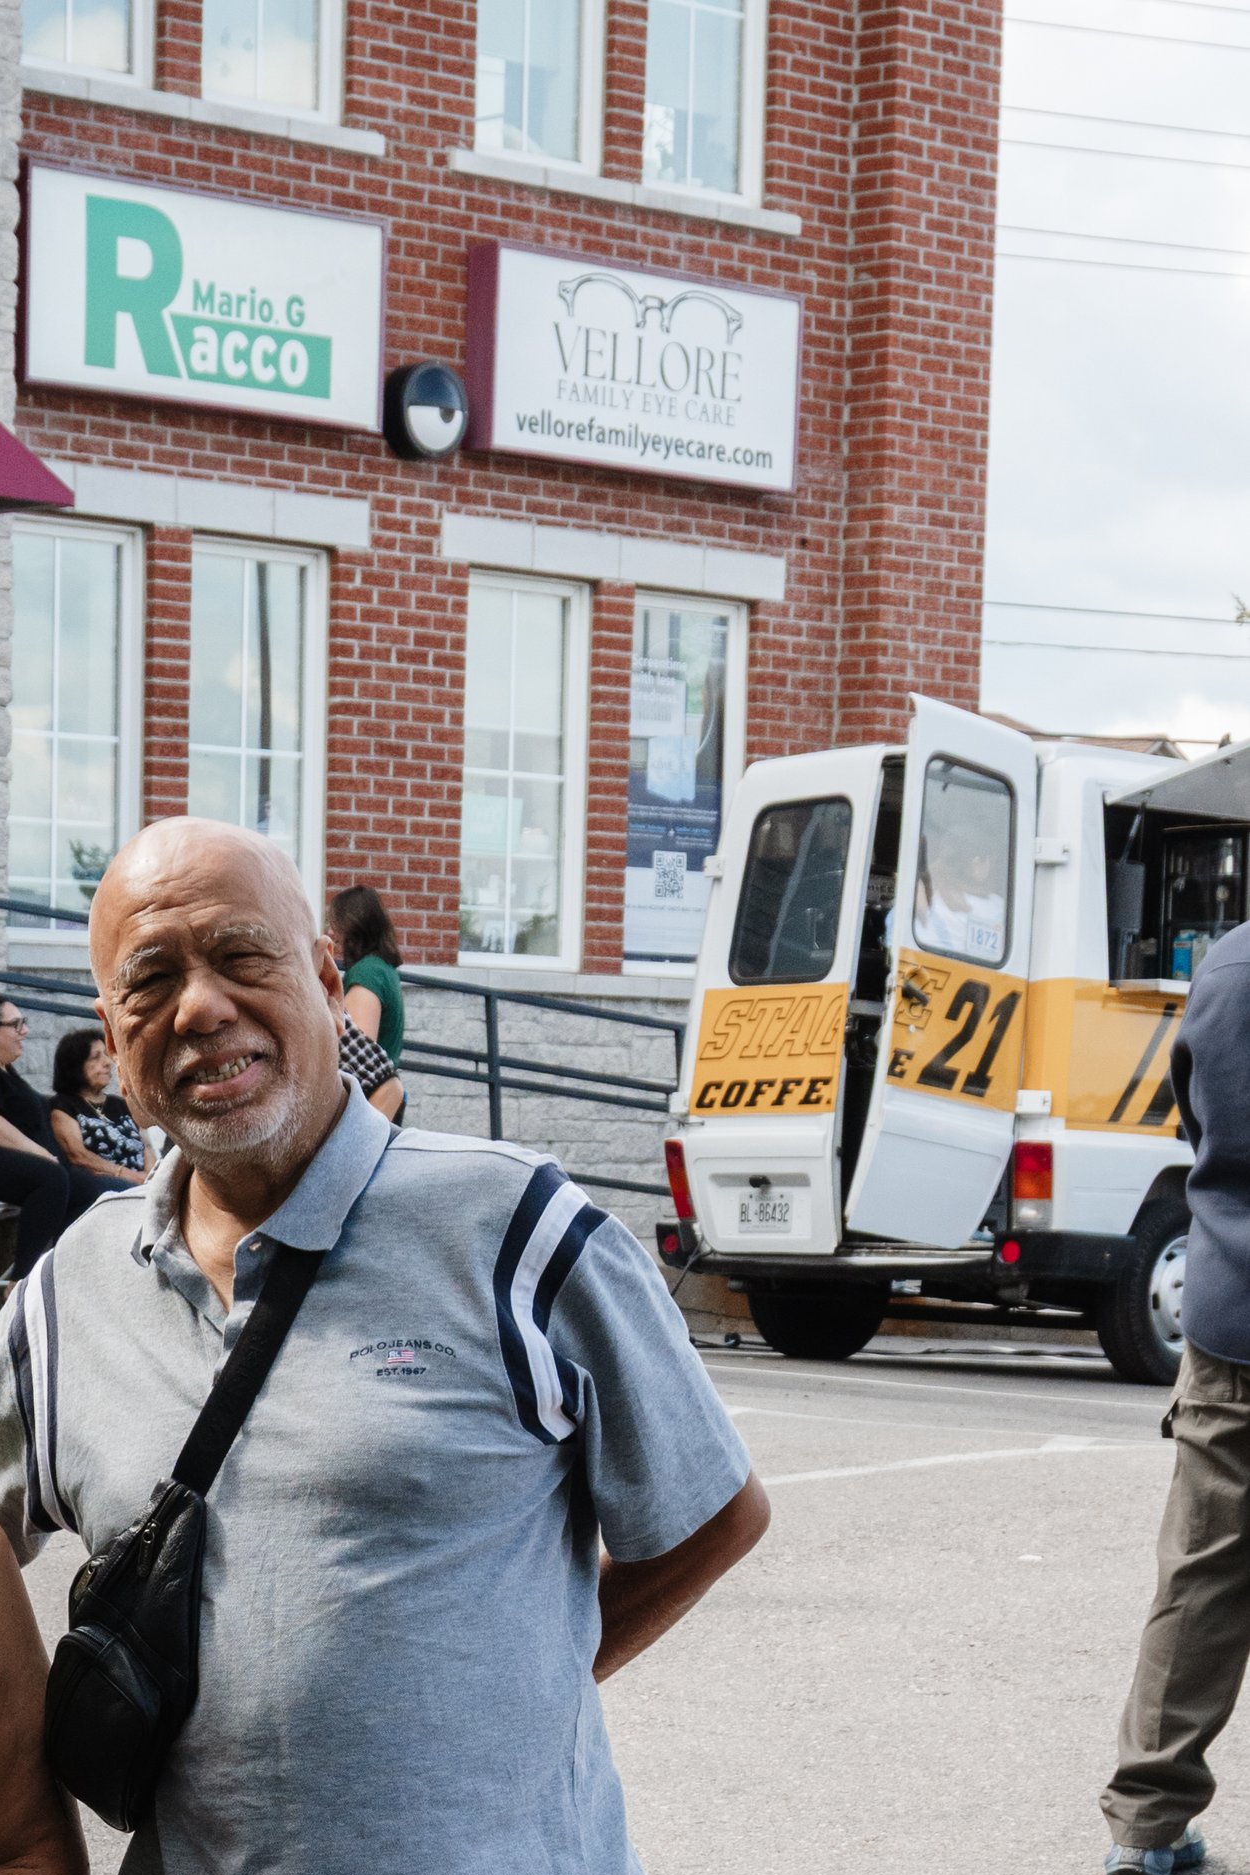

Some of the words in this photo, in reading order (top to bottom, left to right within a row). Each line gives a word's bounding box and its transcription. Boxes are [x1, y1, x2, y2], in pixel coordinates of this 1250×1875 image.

[286, 295, 306, 328] G
[553, 321, 743, 402] VELLORE
[556, 379, 634, 410] FAMILY
[641, 391, 677, 416] EYE
[685, 400, 735, 427] CARE
[516, 409, 773, 469] vellorefamilyeyecare.com
[970, 927, 999, 949] 1872
[917, 978, 1023, 1098] 21
[350, 1341, 387, 1360] POLO
[388, 1339, 432, 1350] JEANS
[434, 1342, 456, 1358] CO.
